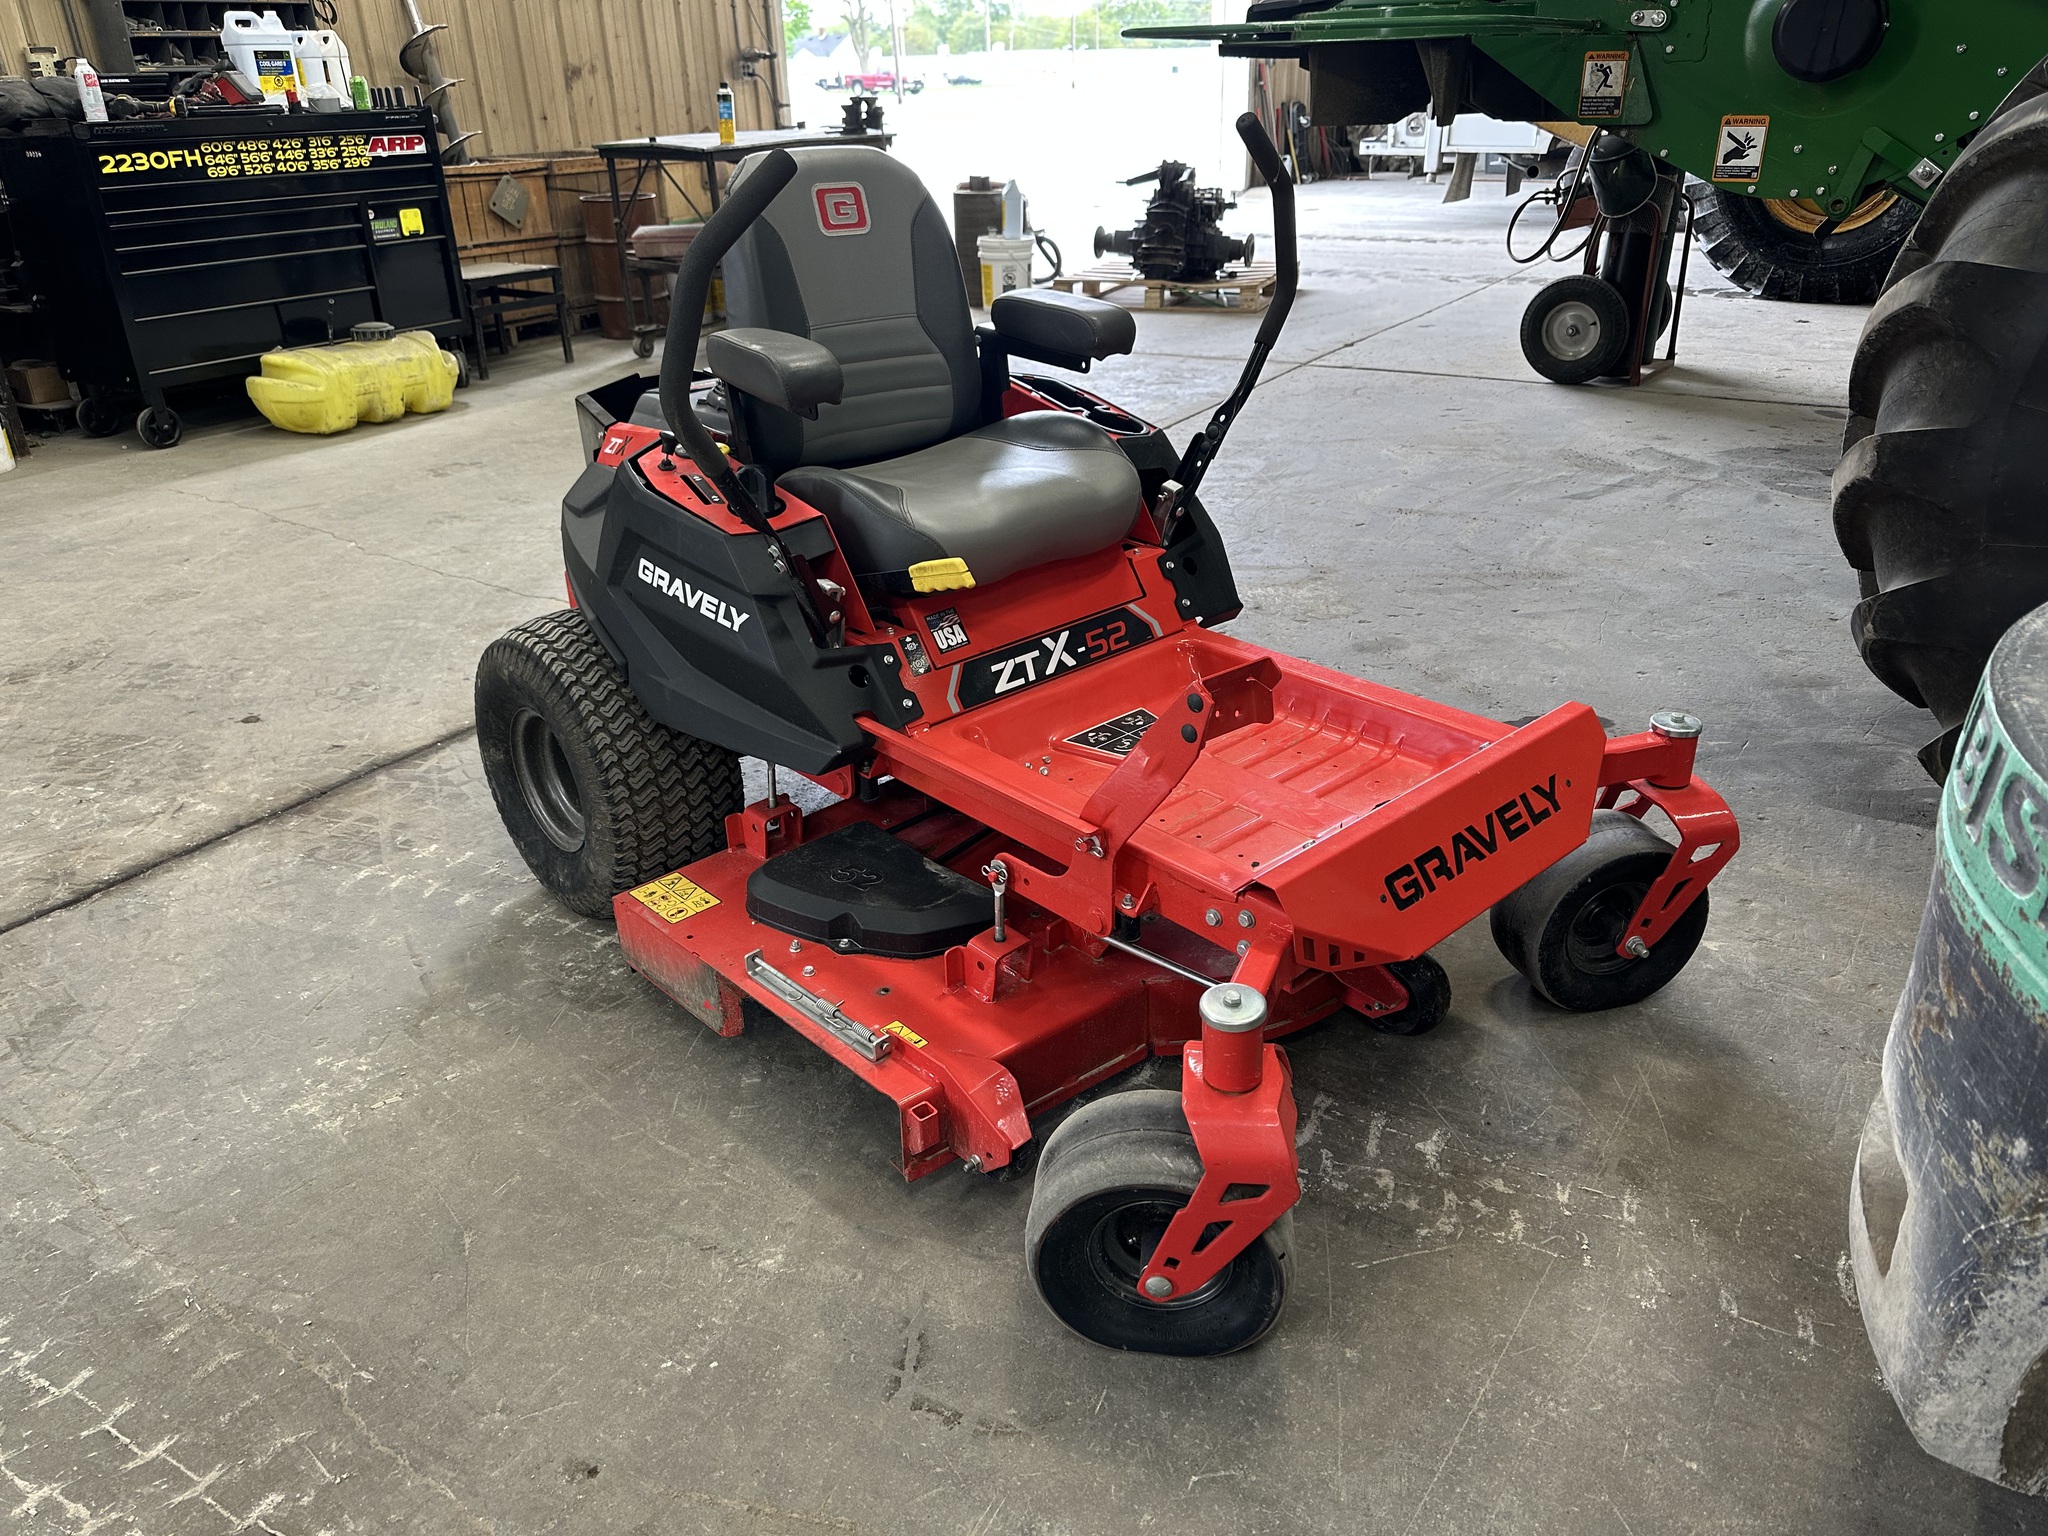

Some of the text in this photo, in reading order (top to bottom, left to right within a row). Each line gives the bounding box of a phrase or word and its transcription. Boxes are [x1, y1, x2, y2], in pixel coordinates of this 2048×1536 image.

[369, 136, 424, 153] ARP
[98, 149, 203, 174] 2230FH
[638, 557, 751, 633] GRAVELY
[933, 624, 968, 650] USA
[1384, 773, 1562, 912] GRAVELY
